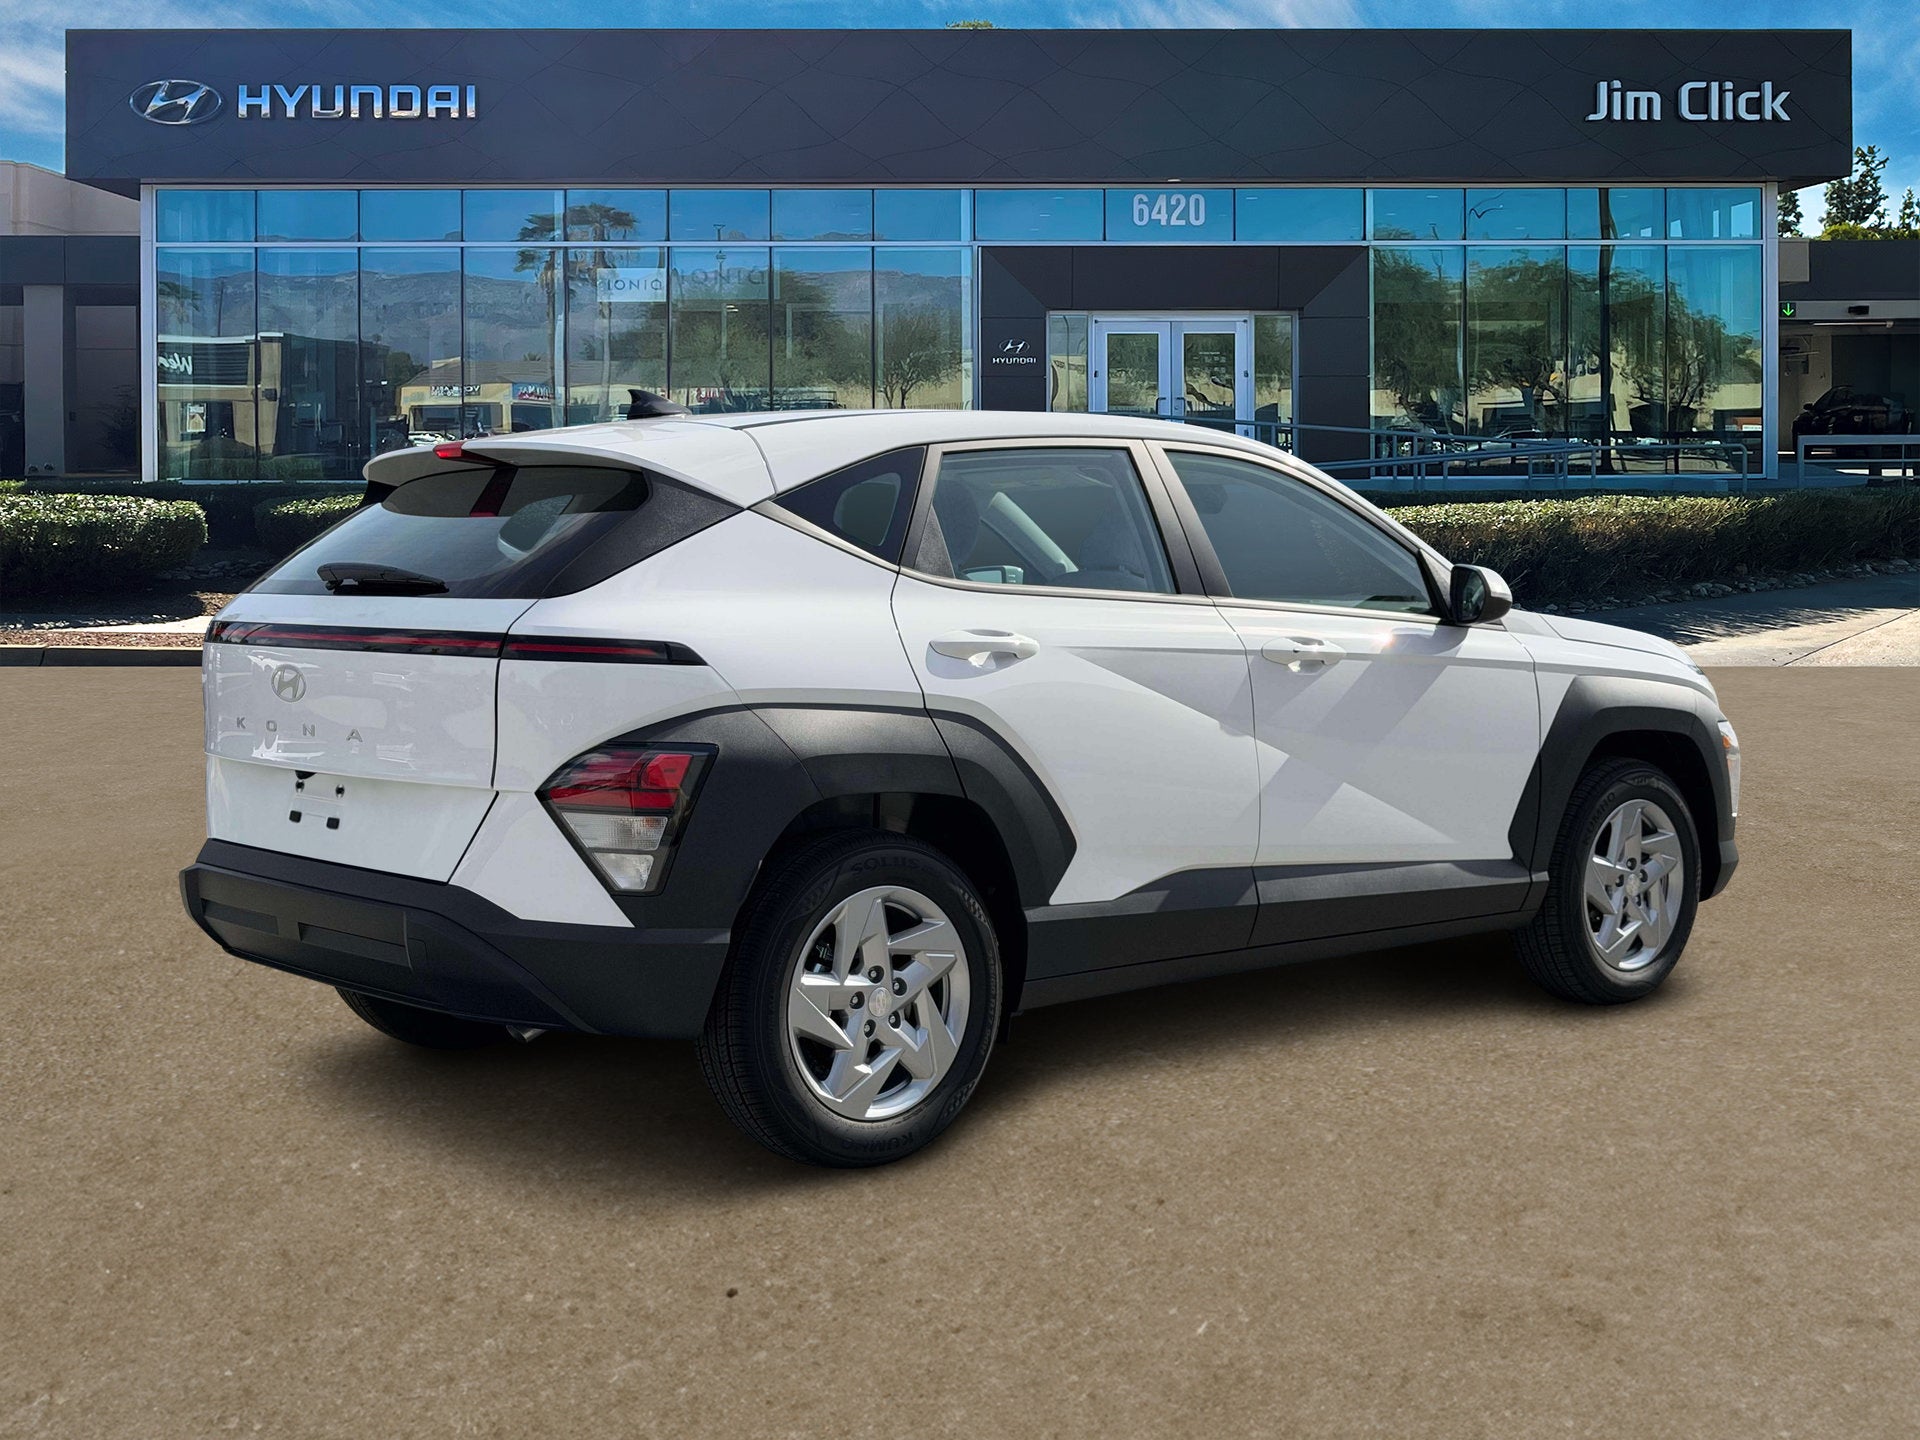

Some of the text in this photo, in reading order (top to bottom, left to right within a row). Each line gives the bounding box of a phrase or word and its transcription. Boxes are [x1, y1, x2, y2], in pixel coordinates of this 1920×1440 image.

[237, 83, 477, 119] HYUNDAI
[1586, 80, 1791, 122] Jim Click
[1132, 193, 1206, 227] 6420
[607, 279, 662, 291] IONIQ
[992, 357, 1036, 365] HYUNDAI
[236, 716, 363, 743] KONA
[851, 856, 921, 876] SOLUS
